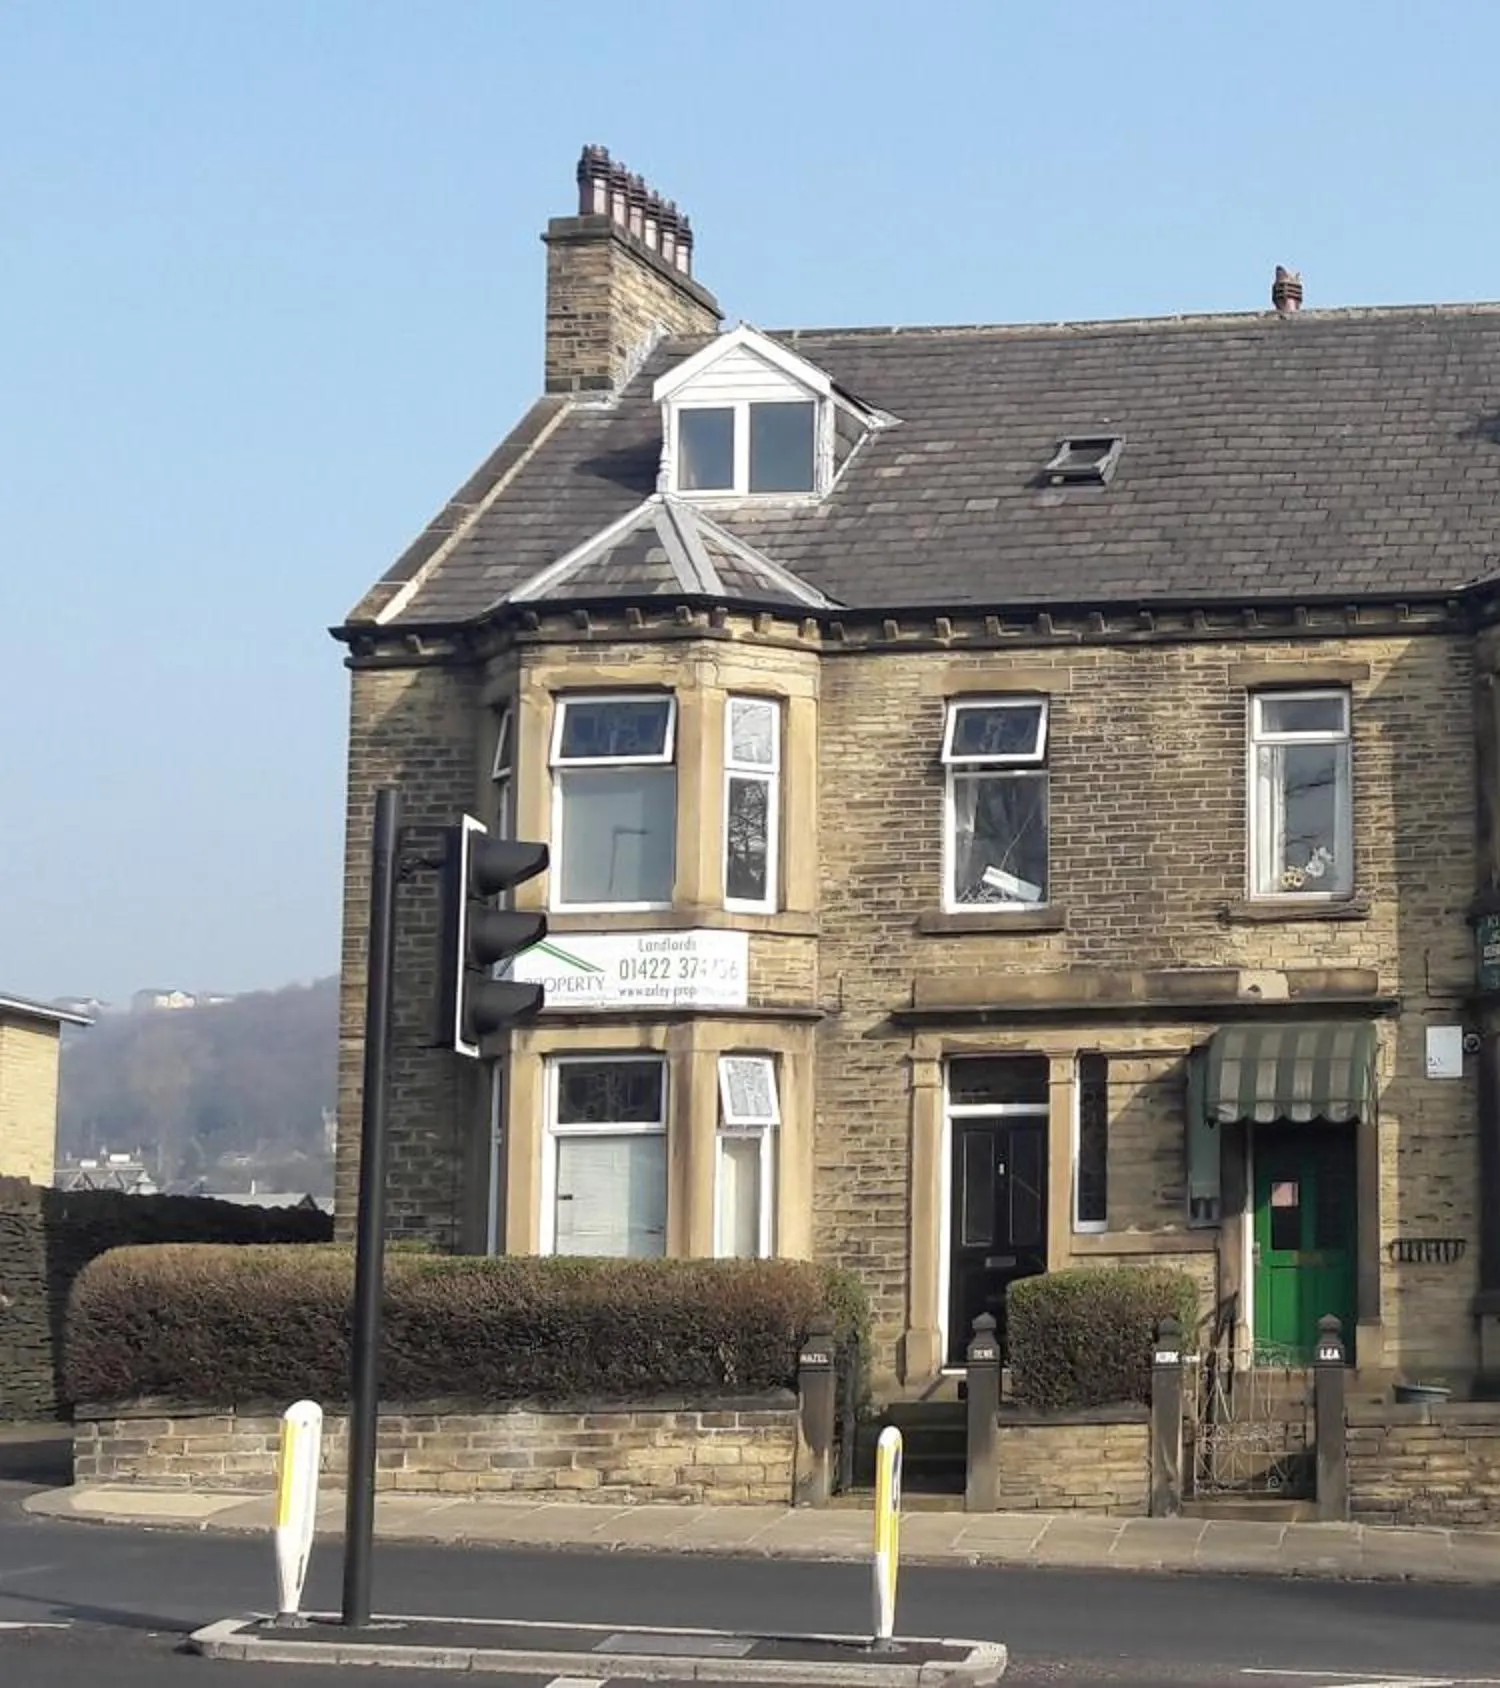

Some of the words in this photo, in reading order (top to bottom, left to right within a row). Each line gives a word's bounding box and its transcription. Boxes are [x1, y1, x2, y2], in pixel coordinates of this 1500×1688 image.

[638, 938, 697, 953] Landlords
[619, 958, 671, 980] 01422
[1320, 1347, 1341, 1360] LEA
